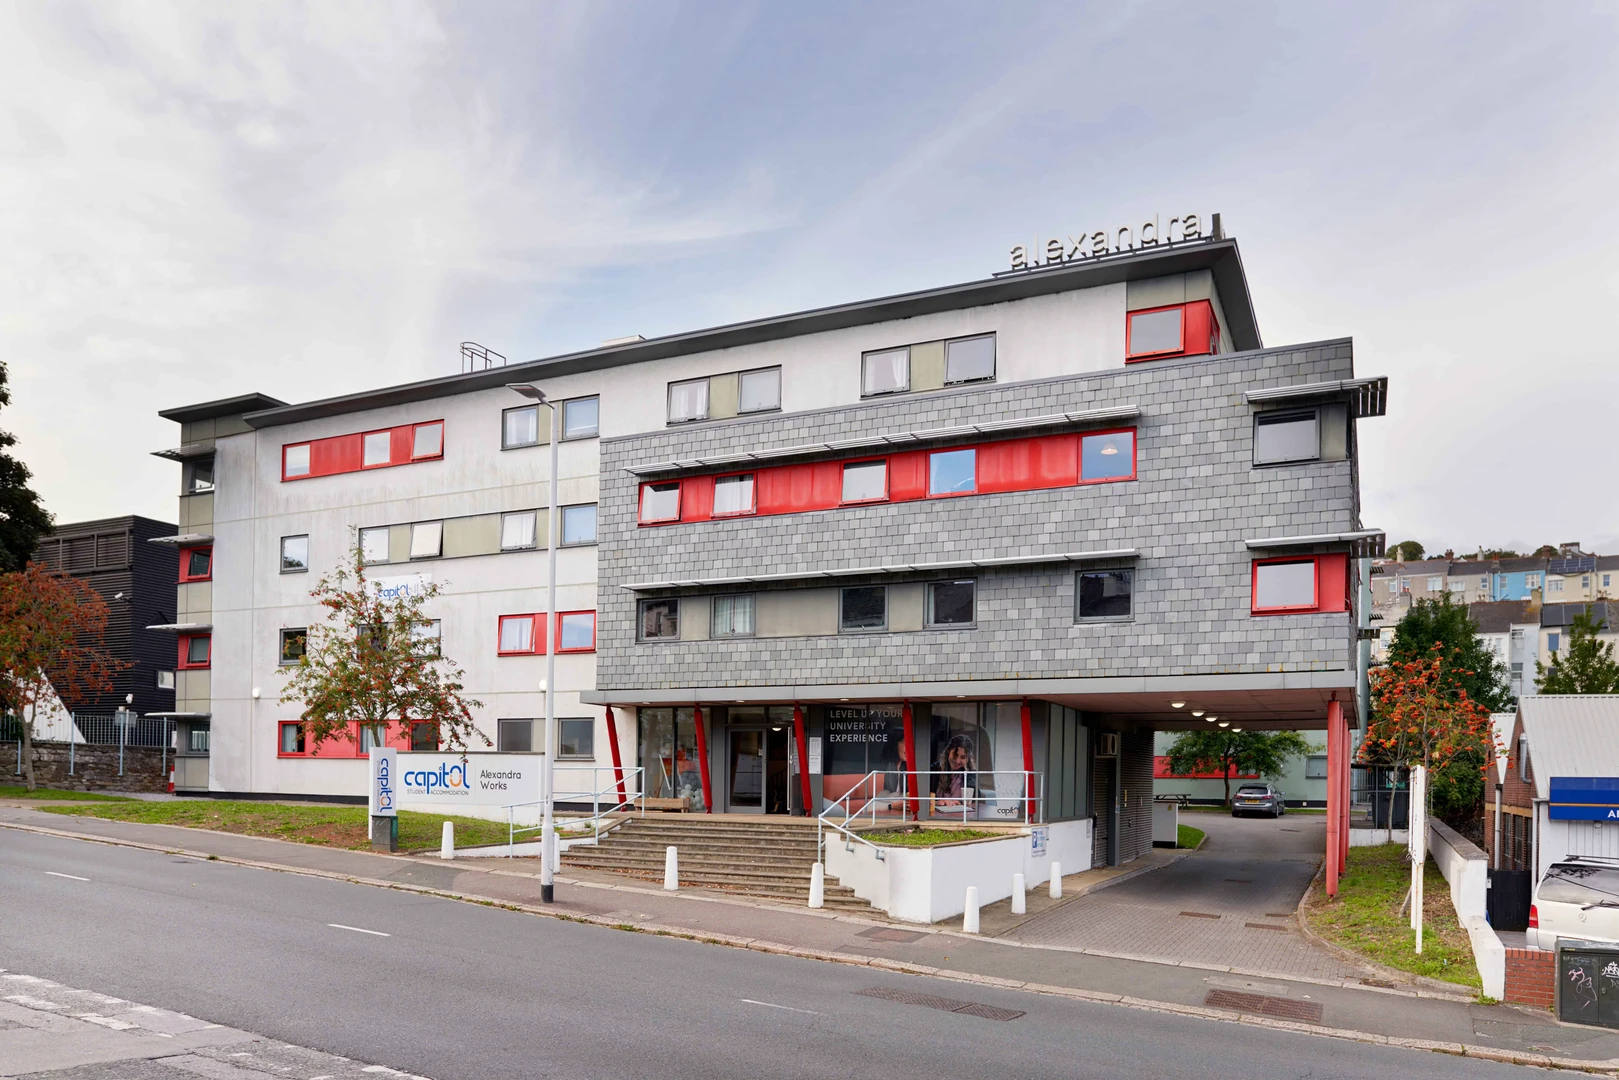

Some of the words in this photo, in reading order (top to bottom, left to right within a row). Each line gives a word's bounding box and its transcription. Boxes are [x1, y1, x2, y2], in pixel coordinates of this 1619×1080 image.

[1010, 212, 1202, 267] alexandra
[830, 710, 858, 718] LEVEL
[861, 710, 874, 718] UP
[876, 710, 903, 718] YOUR
[830, 722, 886, 730] UNIVERSITY
[830, 734, 888, 742] EXPERIENCE
[404, 762, 470, 794] capitol
[480, 770, 521, 780] Alexandra
[377, 758, 393, 812] capitol
[480, 781, 508, 790] Works
